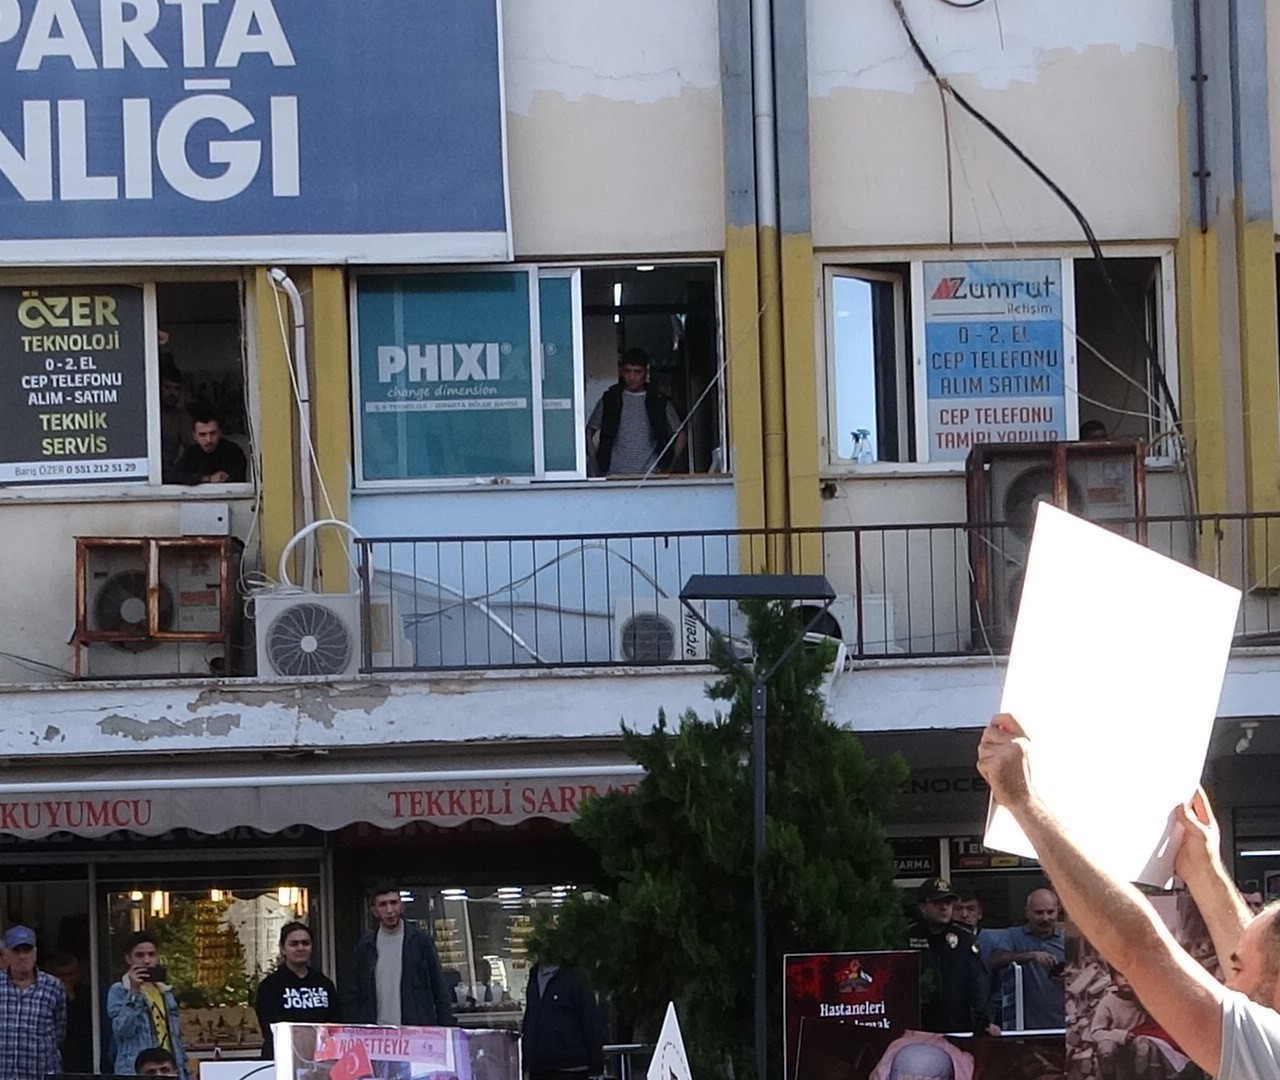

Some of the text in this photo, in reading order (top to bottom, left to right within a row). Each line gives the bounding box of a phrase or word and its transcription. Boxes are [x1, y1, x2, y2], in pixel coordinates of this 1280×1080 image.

[950, 275, 1055, 299] Zümrüt
[18, 291, 120, 329] ÖZER
[1007, 303, 1052, 315] iletişim
[21, 331, 120, 352] TEKNOLOJİ
[80, 357, 97, 371] EL
[377, 343, 500, 382] PHIXI
[932, 350, 1058, 370] CEP TELEFONU
[21, 372, 122, 389] CEP TELEFONU
[941, 375, 1051, 395] ALIM SATIMI
[28, 389, 117, 405] ALIM SATIM
[387, 383, 498, 399] change dimension
[39, 410, 108, 432] TEKNİK
[940, 407, 1053, 426] CEP TELEFONU
[41, 433, 108, 456] SERVİS
[15, 463, 37, 477] Barış
[38, 460, 64, 475] ÖZER
[66, 463, 73, 475] 0
[75, 462, 90, 474] 551
[93, 462, 109, 474] 212
[124, 462, 136, 473] 29
[388, 781, 512, 819] TEKKELİ
[0, 798, 154, 830] KUYUMCU
[284, 997, 329, 1009] JONES
[820, 1001, 886, 1017] Hastaneleri
